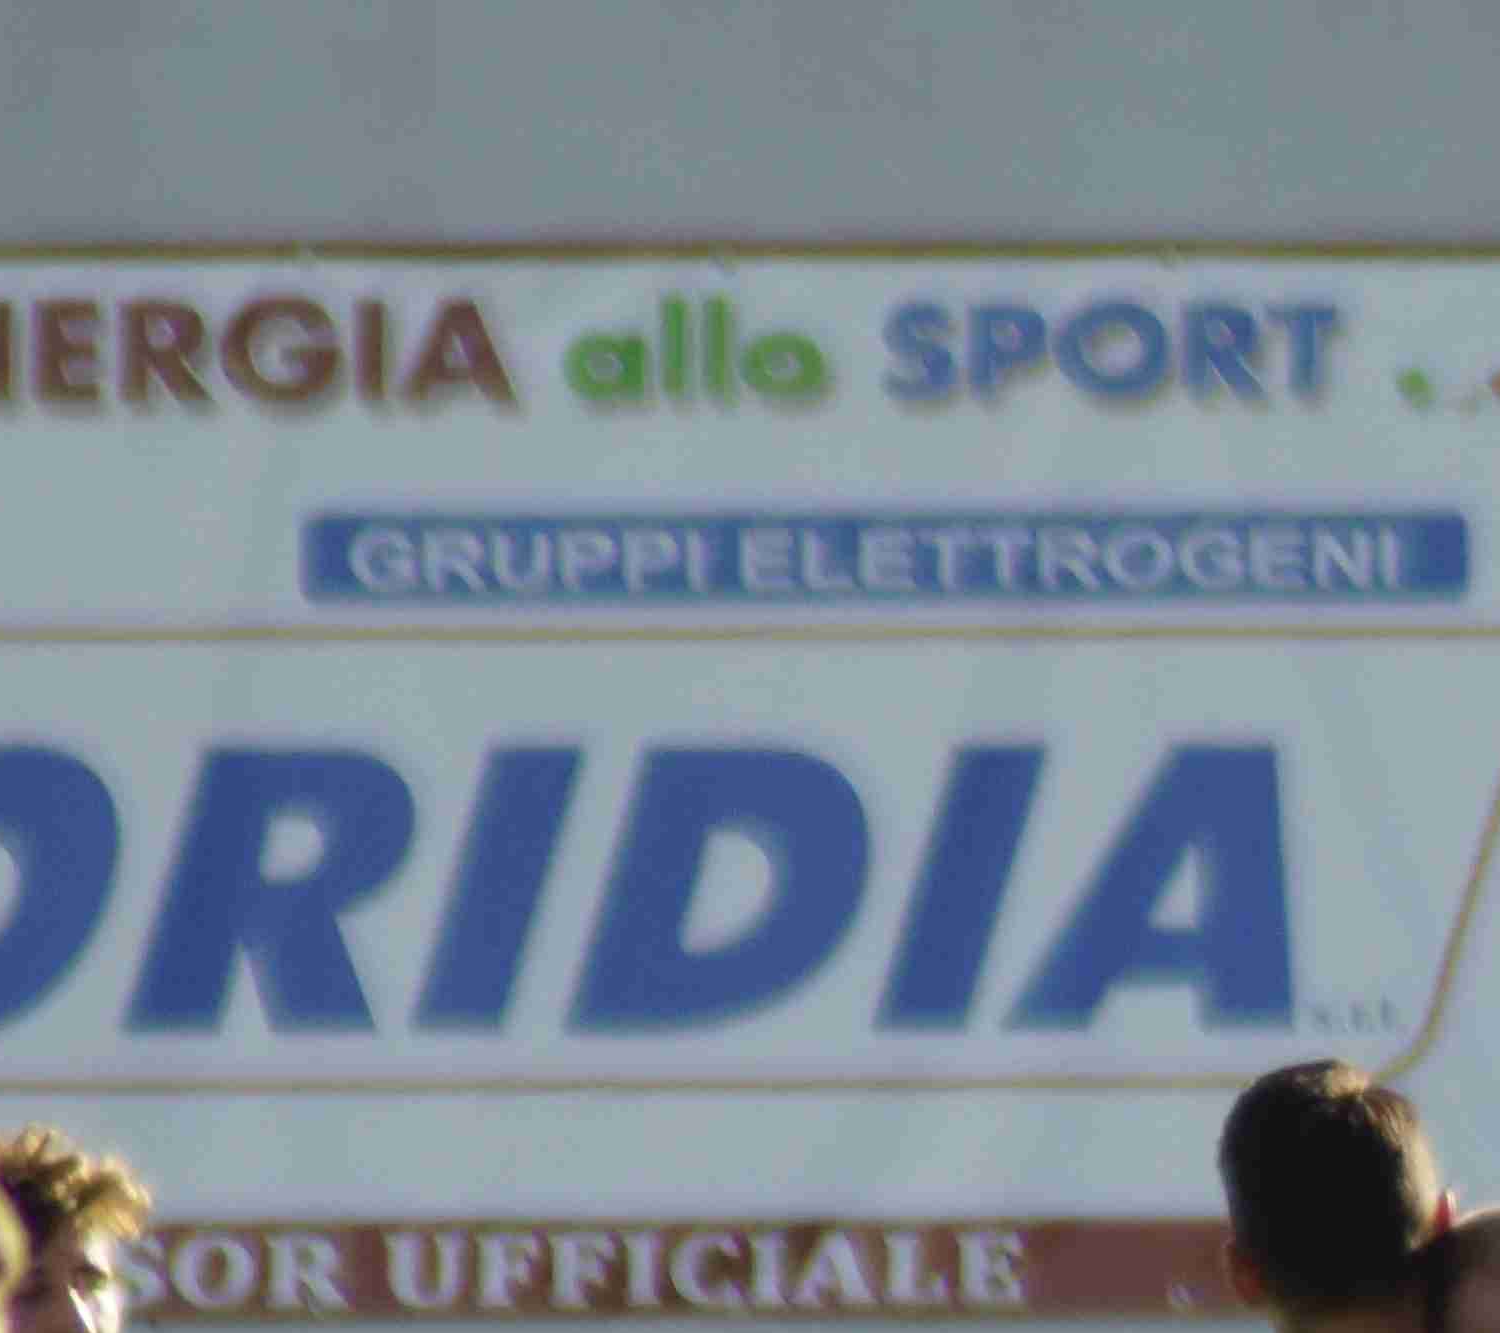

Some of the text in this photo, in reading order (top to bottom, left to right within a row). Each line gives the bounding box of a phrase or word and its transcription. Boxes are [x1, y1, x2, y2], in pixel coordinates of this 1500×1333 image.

[564, 297, 828, 400] allo
[881, 300, 1338, 402] SPORT
[348, 526, 1404, 592] GRUPPI ELETTROGENI
[122, 1230, 1028, 1316] SOR UFFICIALE
